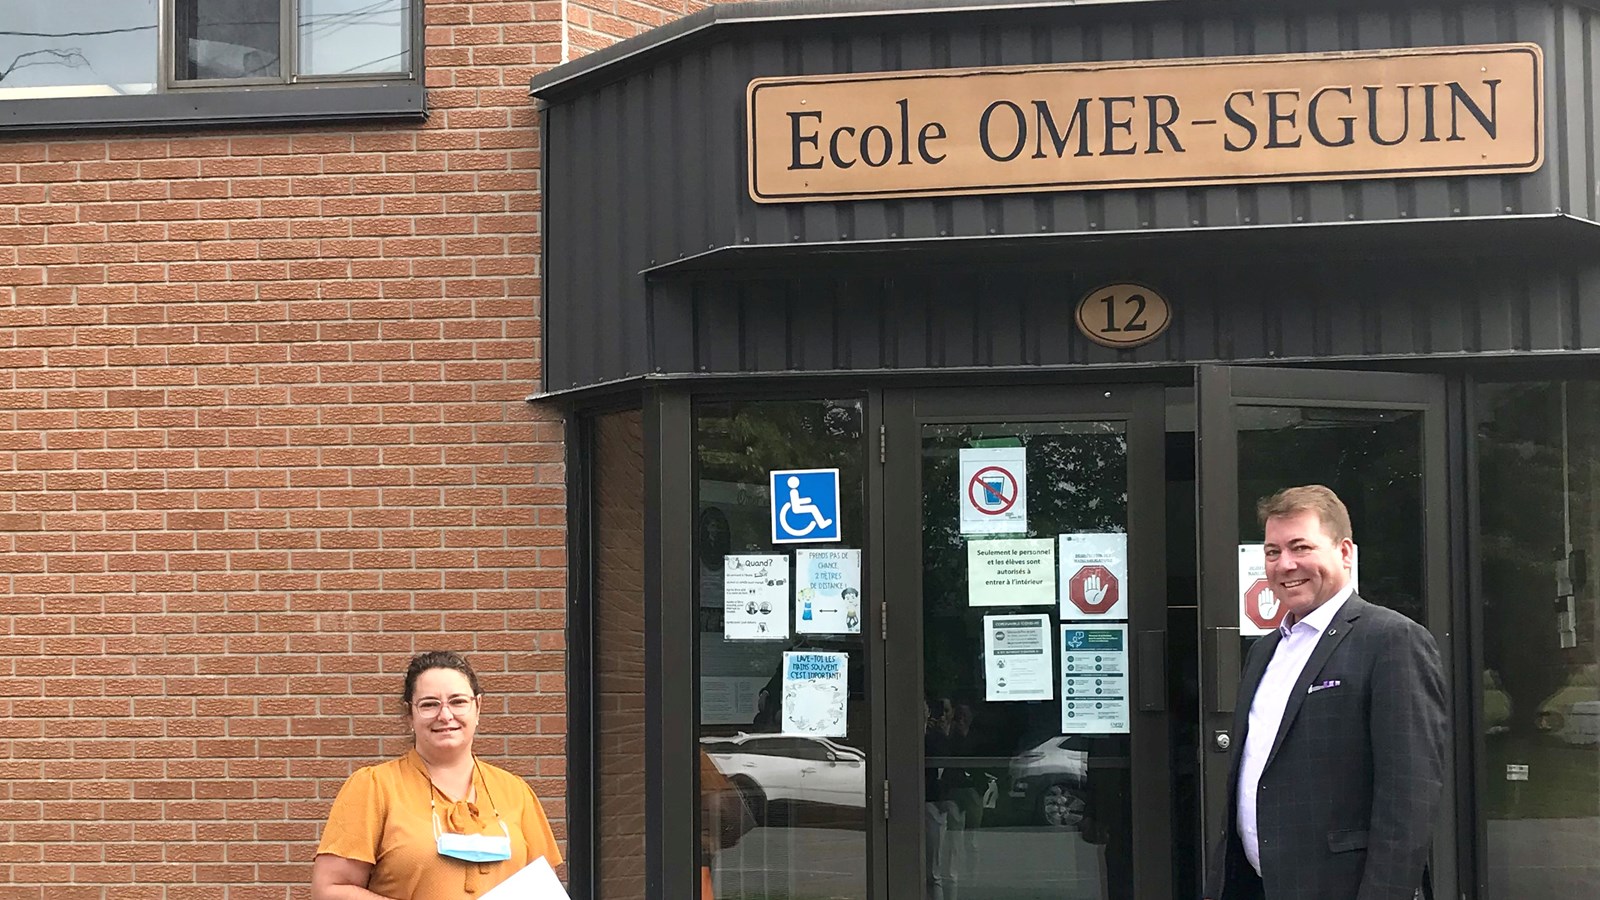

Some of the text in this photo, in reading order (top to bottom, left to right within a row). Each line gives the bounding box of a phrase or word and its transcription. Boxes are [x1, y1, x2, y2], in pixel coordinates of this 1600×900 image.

[786, 79, 1502, 170] Ecole OMER-SEGUIN
[1100, 294, 1147, 332] 12
[745, 559, 774, 567] Quand?
[815, 572, 819, 580] 2
[825, 655, 836, 663] LES
